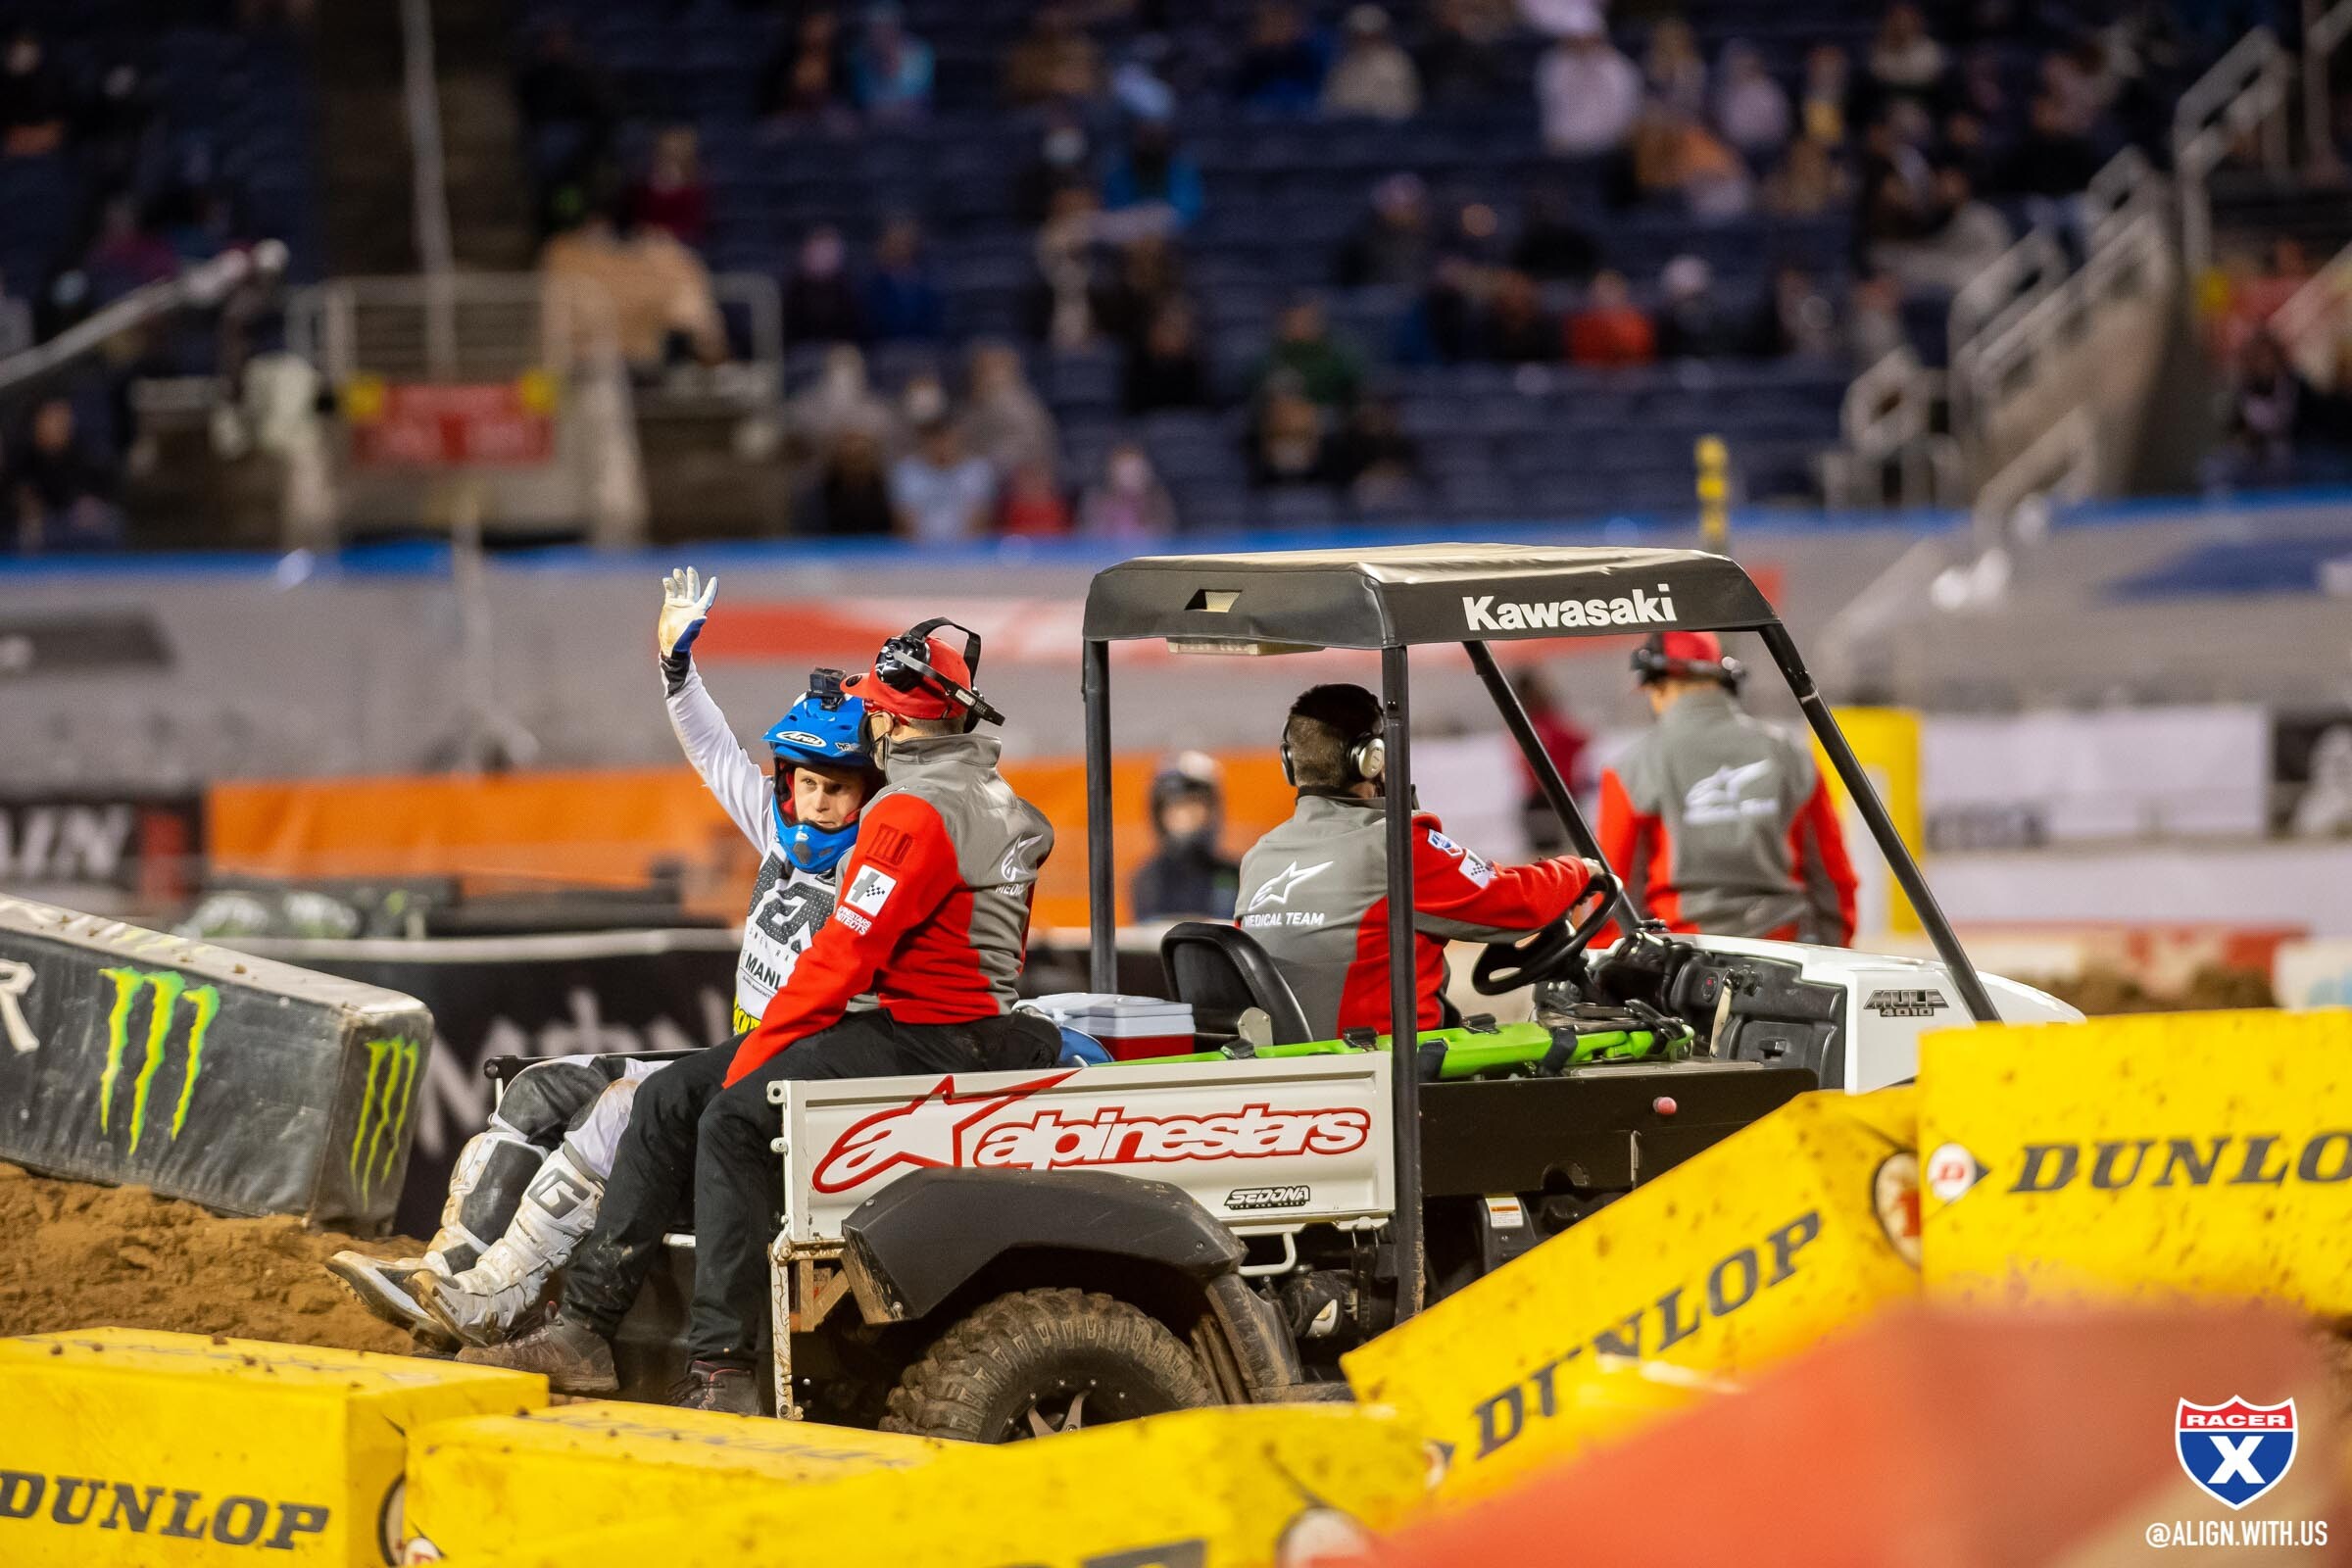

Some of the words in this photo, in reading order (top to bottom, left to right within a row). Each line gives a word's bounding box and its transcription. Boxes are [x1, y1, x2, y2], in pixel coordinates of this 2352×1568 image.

[1462, 584, 1678, 630] Kawasaki
[1286, 912, 1325, 926] TEAM
[1863, 990, 1949, 1009] MULE
[1880, 1007, 1934, 1017] 4010
[973, 1103, 1372, 1171] alpinestars
[1225, 1186, 1309, 1205] SEDONA
[0, 1470, 329, 1550] DUNLOP
